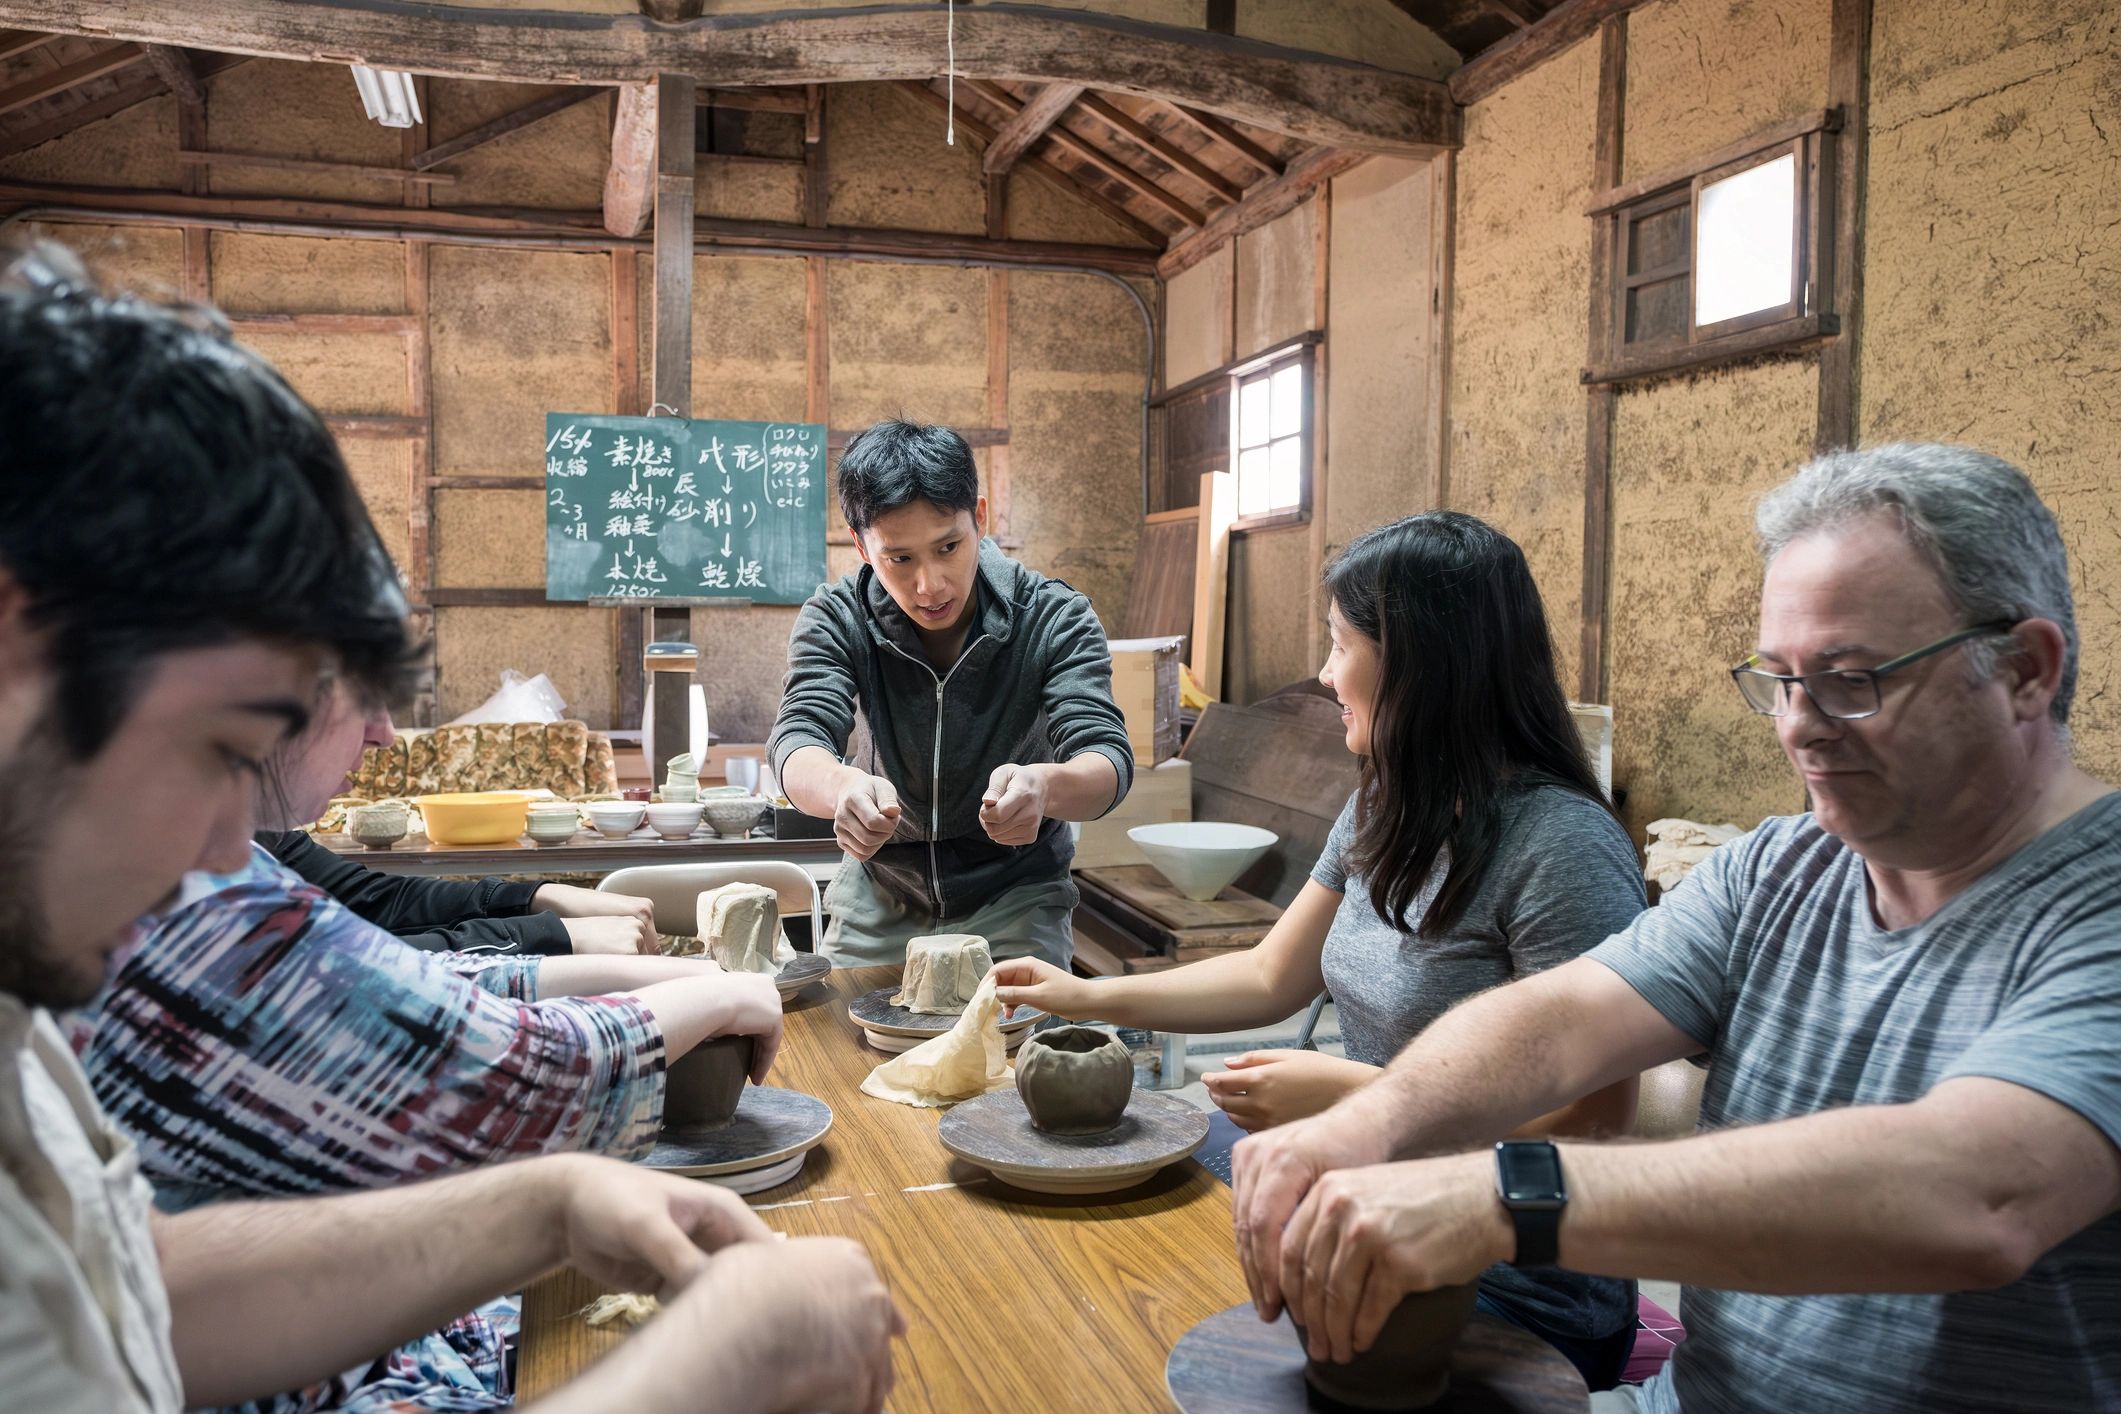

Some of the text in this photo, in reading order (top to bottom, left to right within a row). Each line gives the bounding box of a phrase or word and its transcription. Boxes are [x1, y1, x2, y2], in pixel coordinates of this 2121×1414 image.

[545, 424, 592, 455] 15%
[773, 429, 810, 440] ロクロ
[604, 435, 672, 467] 素焼き
[699, 435, 765, 474] 成形
[770, 444, 819, 460] 手びねり
[546, 456, 588, 477] 収縮
[608, 483, 667, 513] 絵付け
[771, 478, 811, 489] いこみ
[777, 488, 806, 507] etc
[704, 498, 757, 529] 削り
[603, 552, 668, 582] 本焼
[699, 556, 767, 589] 乾燥
